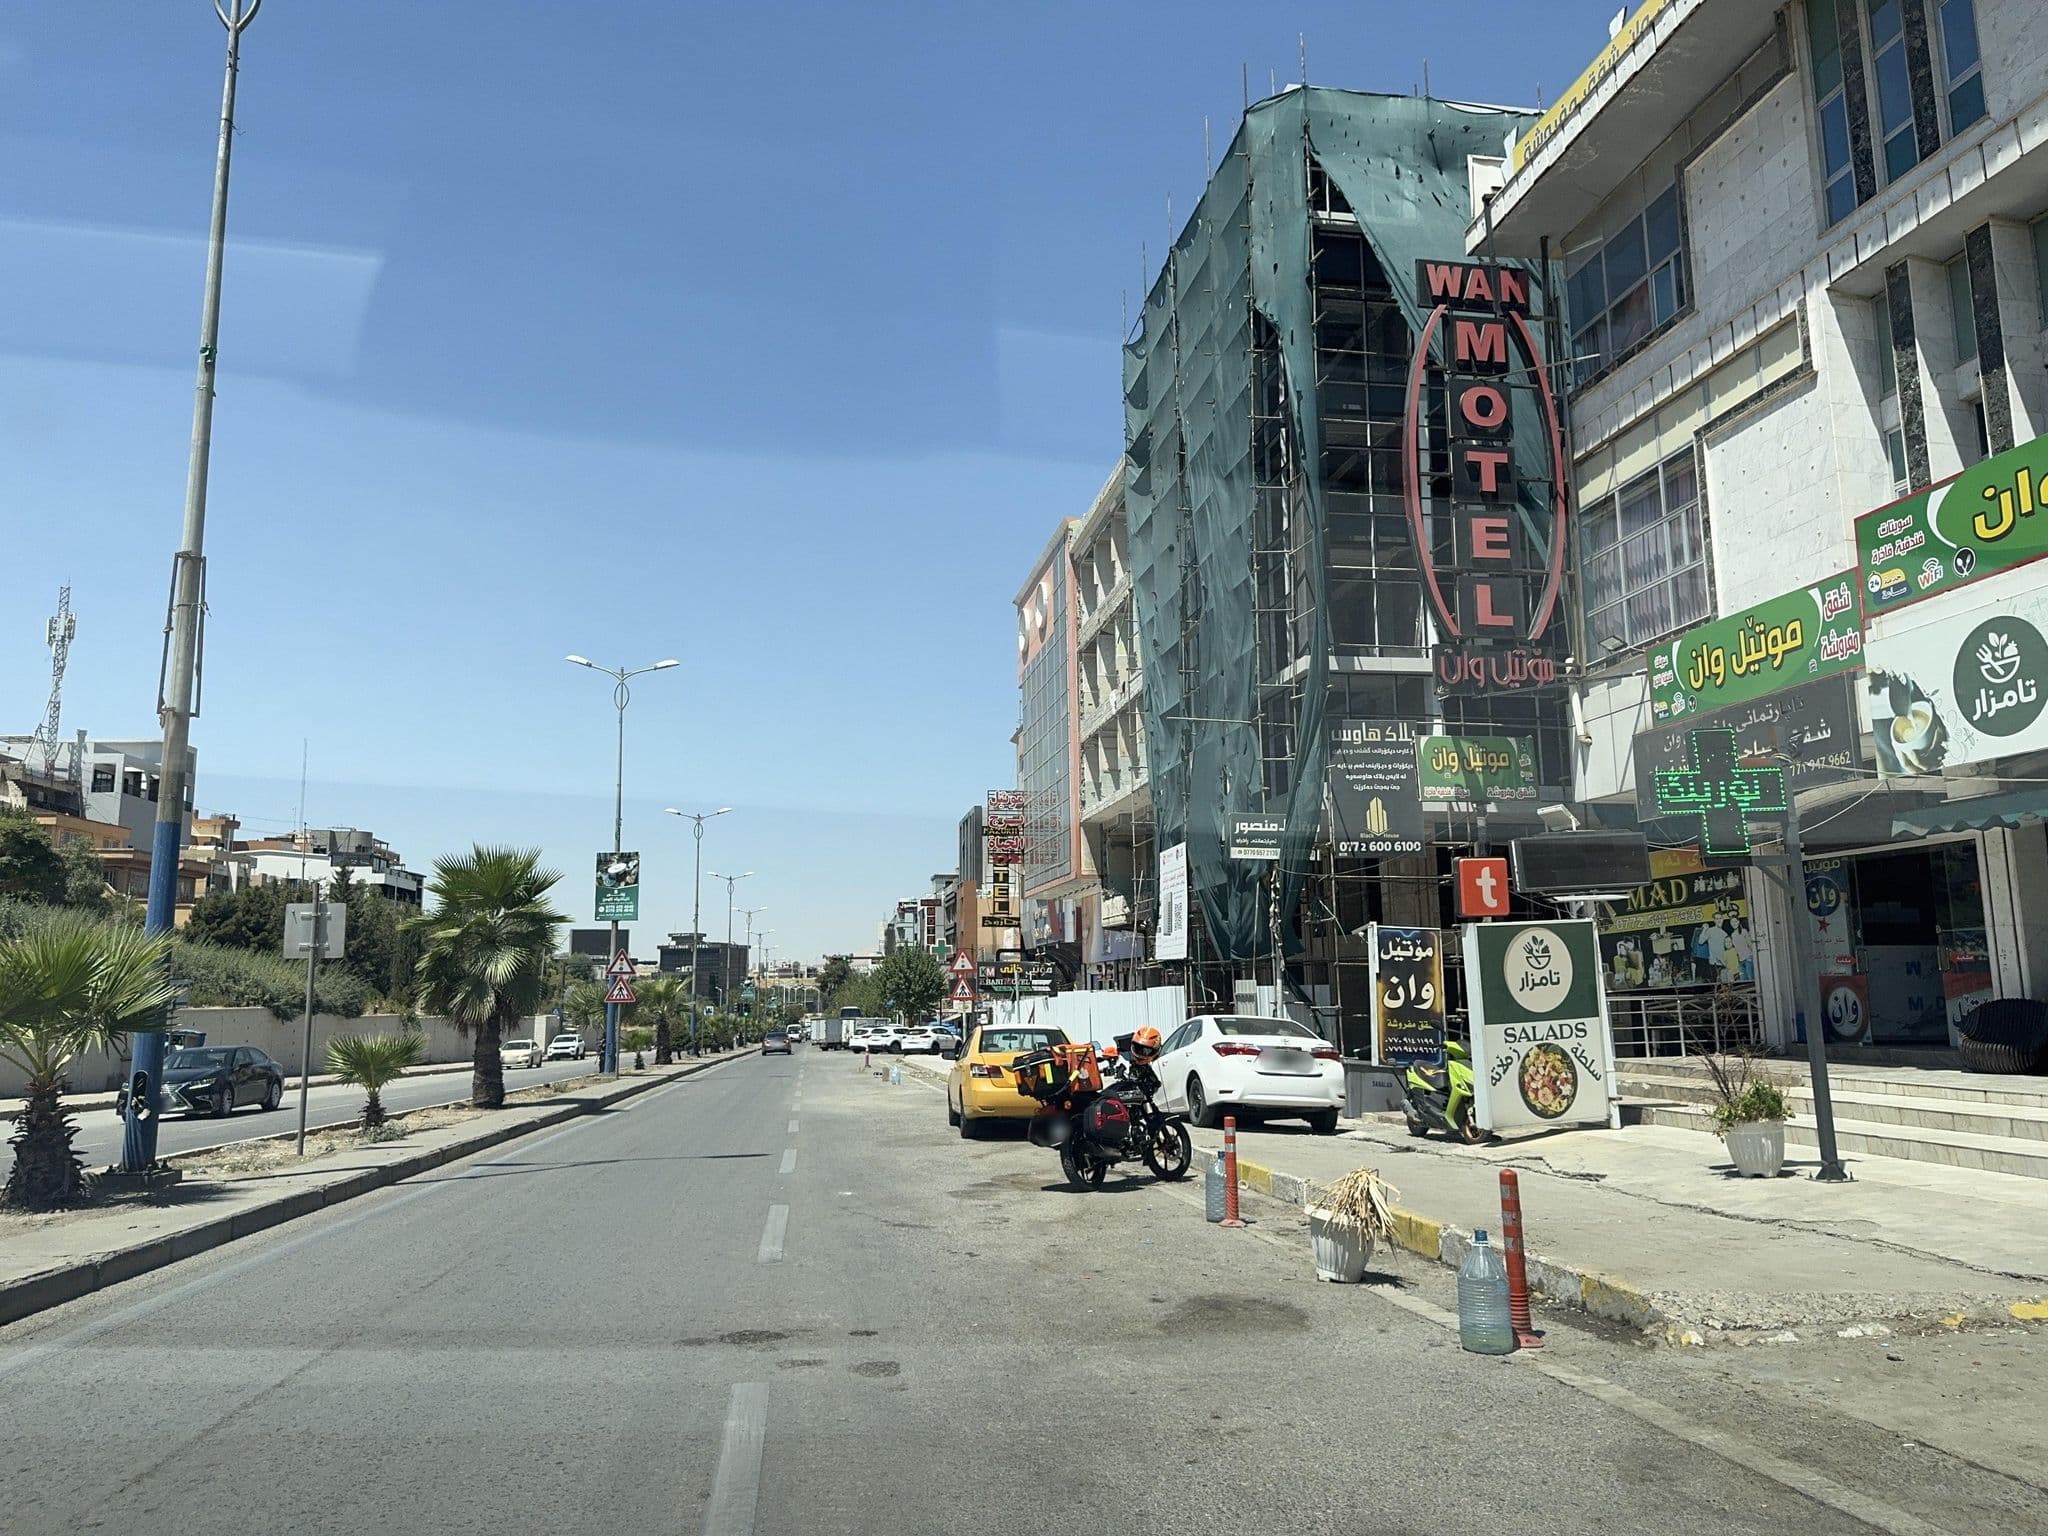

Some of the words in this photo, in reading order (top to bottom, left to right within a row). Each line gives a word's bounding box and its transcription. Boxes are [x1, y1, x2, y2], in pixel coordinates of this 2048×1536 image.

[1426, 264, 1526, 304] WAN
[1455, 320, 1515, 627] MOTEL
[1823, 582, 1852, 622] شقق
[1820, 628, 1861, 661] مفروشة
[1440, 648, 1486, 688] وان
[1688, 644, 1725, 689] وان
[1972, 677, 2038, 721] تامزار
[1432, 746, 1459, 774] وان
[1369, 841, 1392, 852] 600
[1808, 883, 1837, 909] وان
[1383, 974, 1435, 1010] وان
[1519, 969, 1561, 992] تامزار
[1831, 993, 1860, 1025] وان
[1503, 1021, 1589, 1044] SALADS
